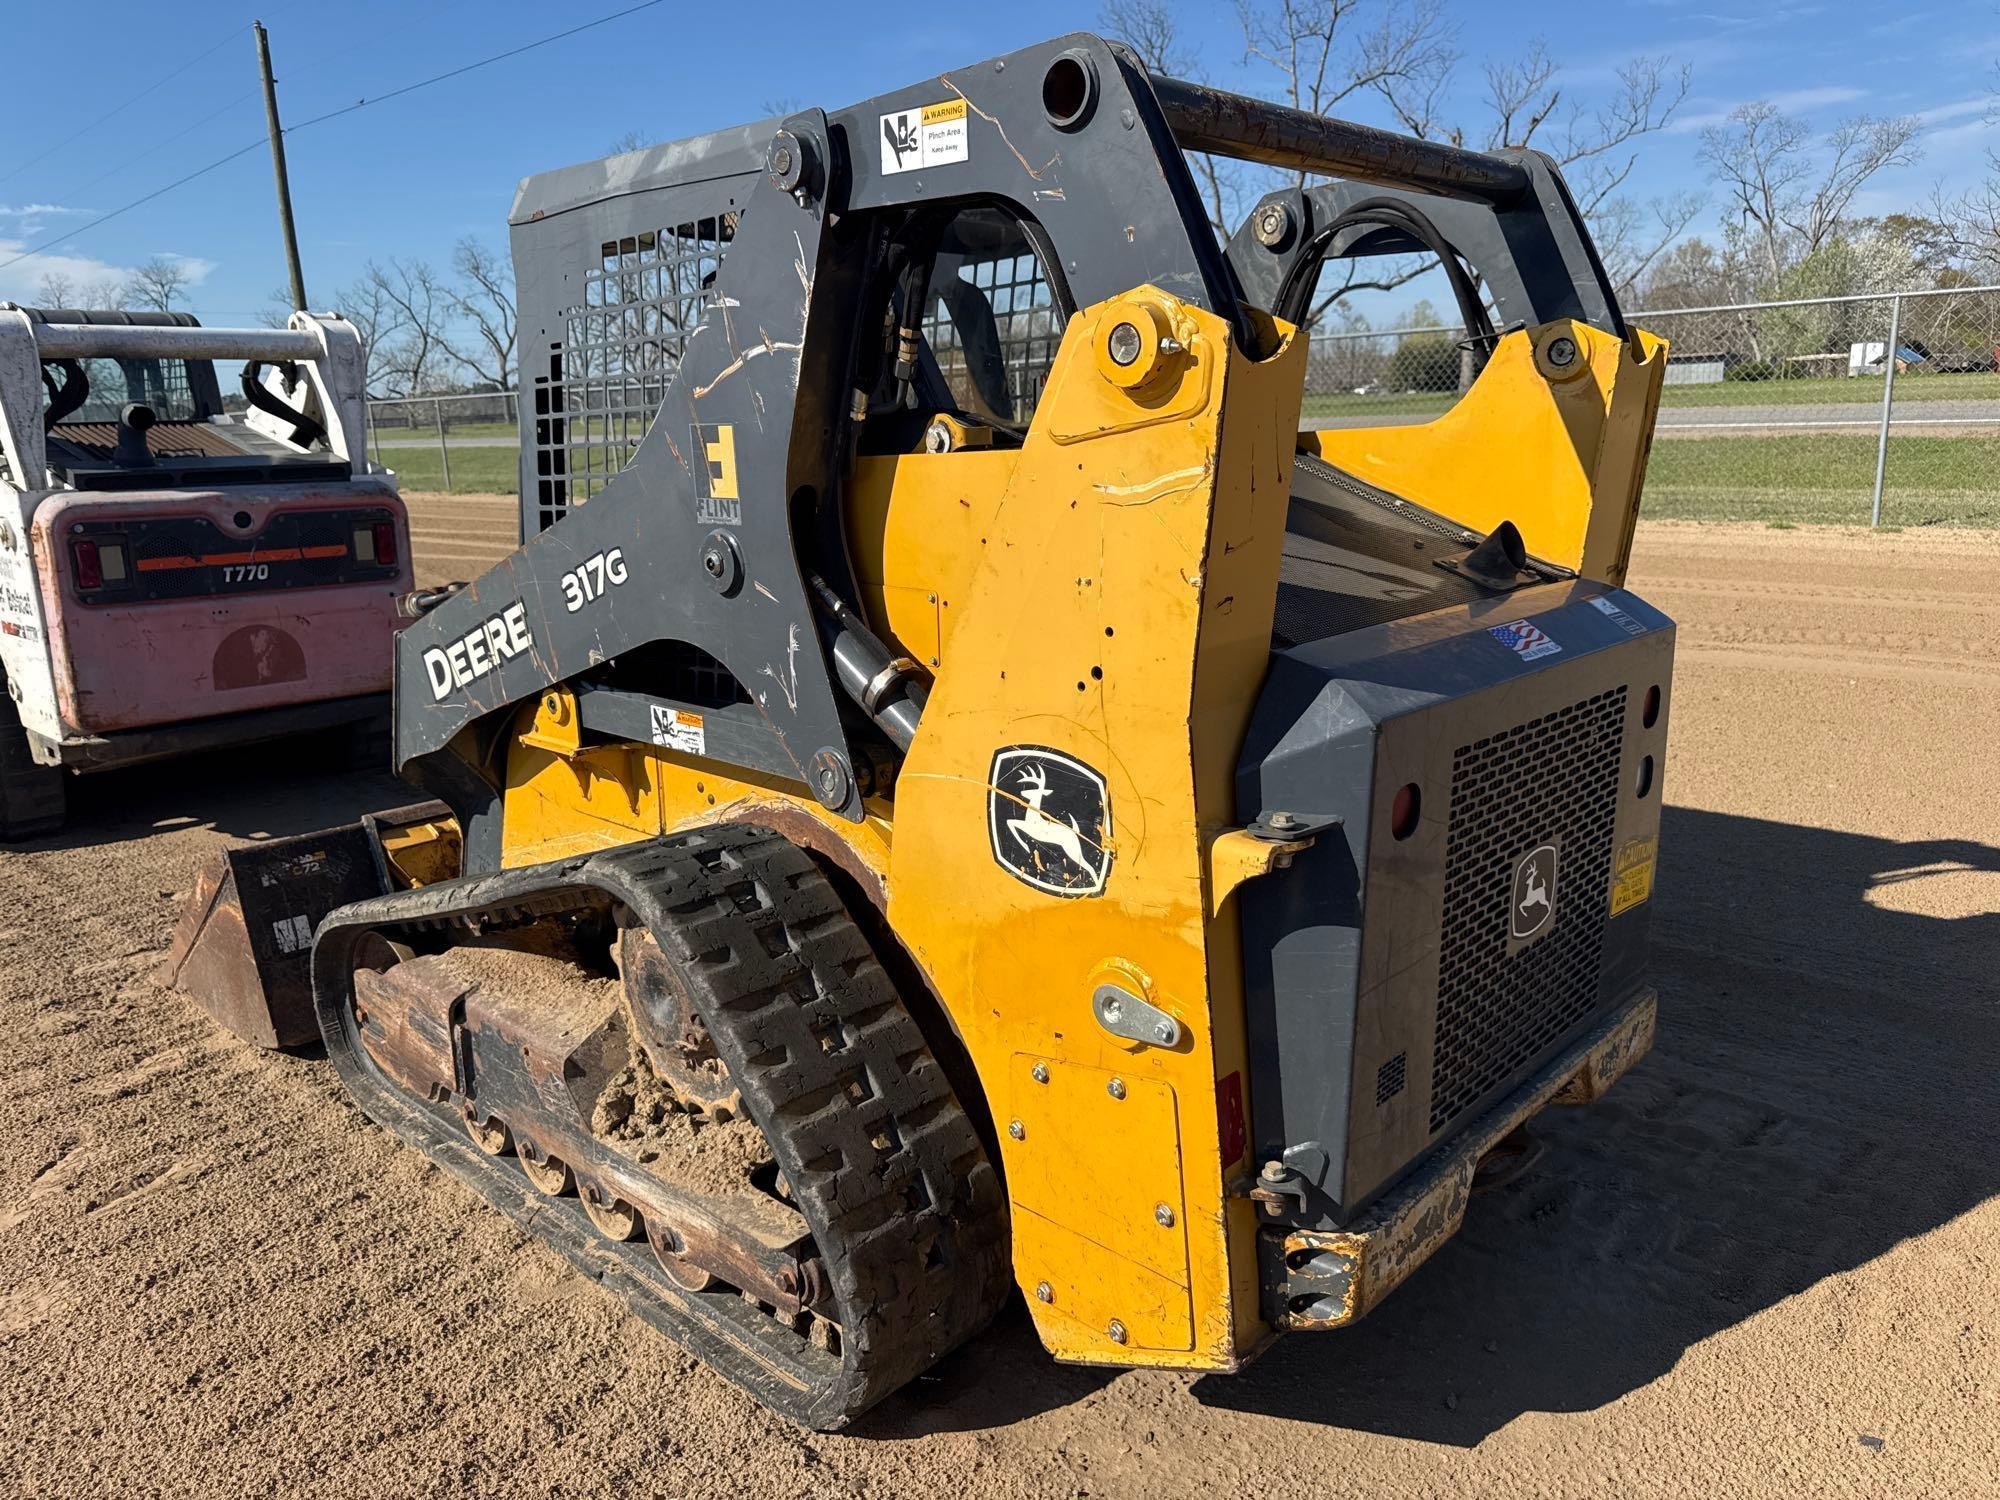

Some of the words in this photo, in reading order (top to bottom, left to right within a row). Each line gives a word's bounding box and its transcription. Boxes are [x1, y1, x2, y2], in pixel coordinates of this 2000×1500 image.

[930, 105, 963, 118] WARNING
[928, 131, 945, 140] Pinch
[947, 128, 961, 136] Area
[931, 145, 944, 153] Keep
[945, 143, 958, 152] Away
[696, 499, 739, 518] FLINT
[223, 564, 269, 583] T770
[561, 548, 629, 614] 317G
[423, 601, 533, 702] DEERE
